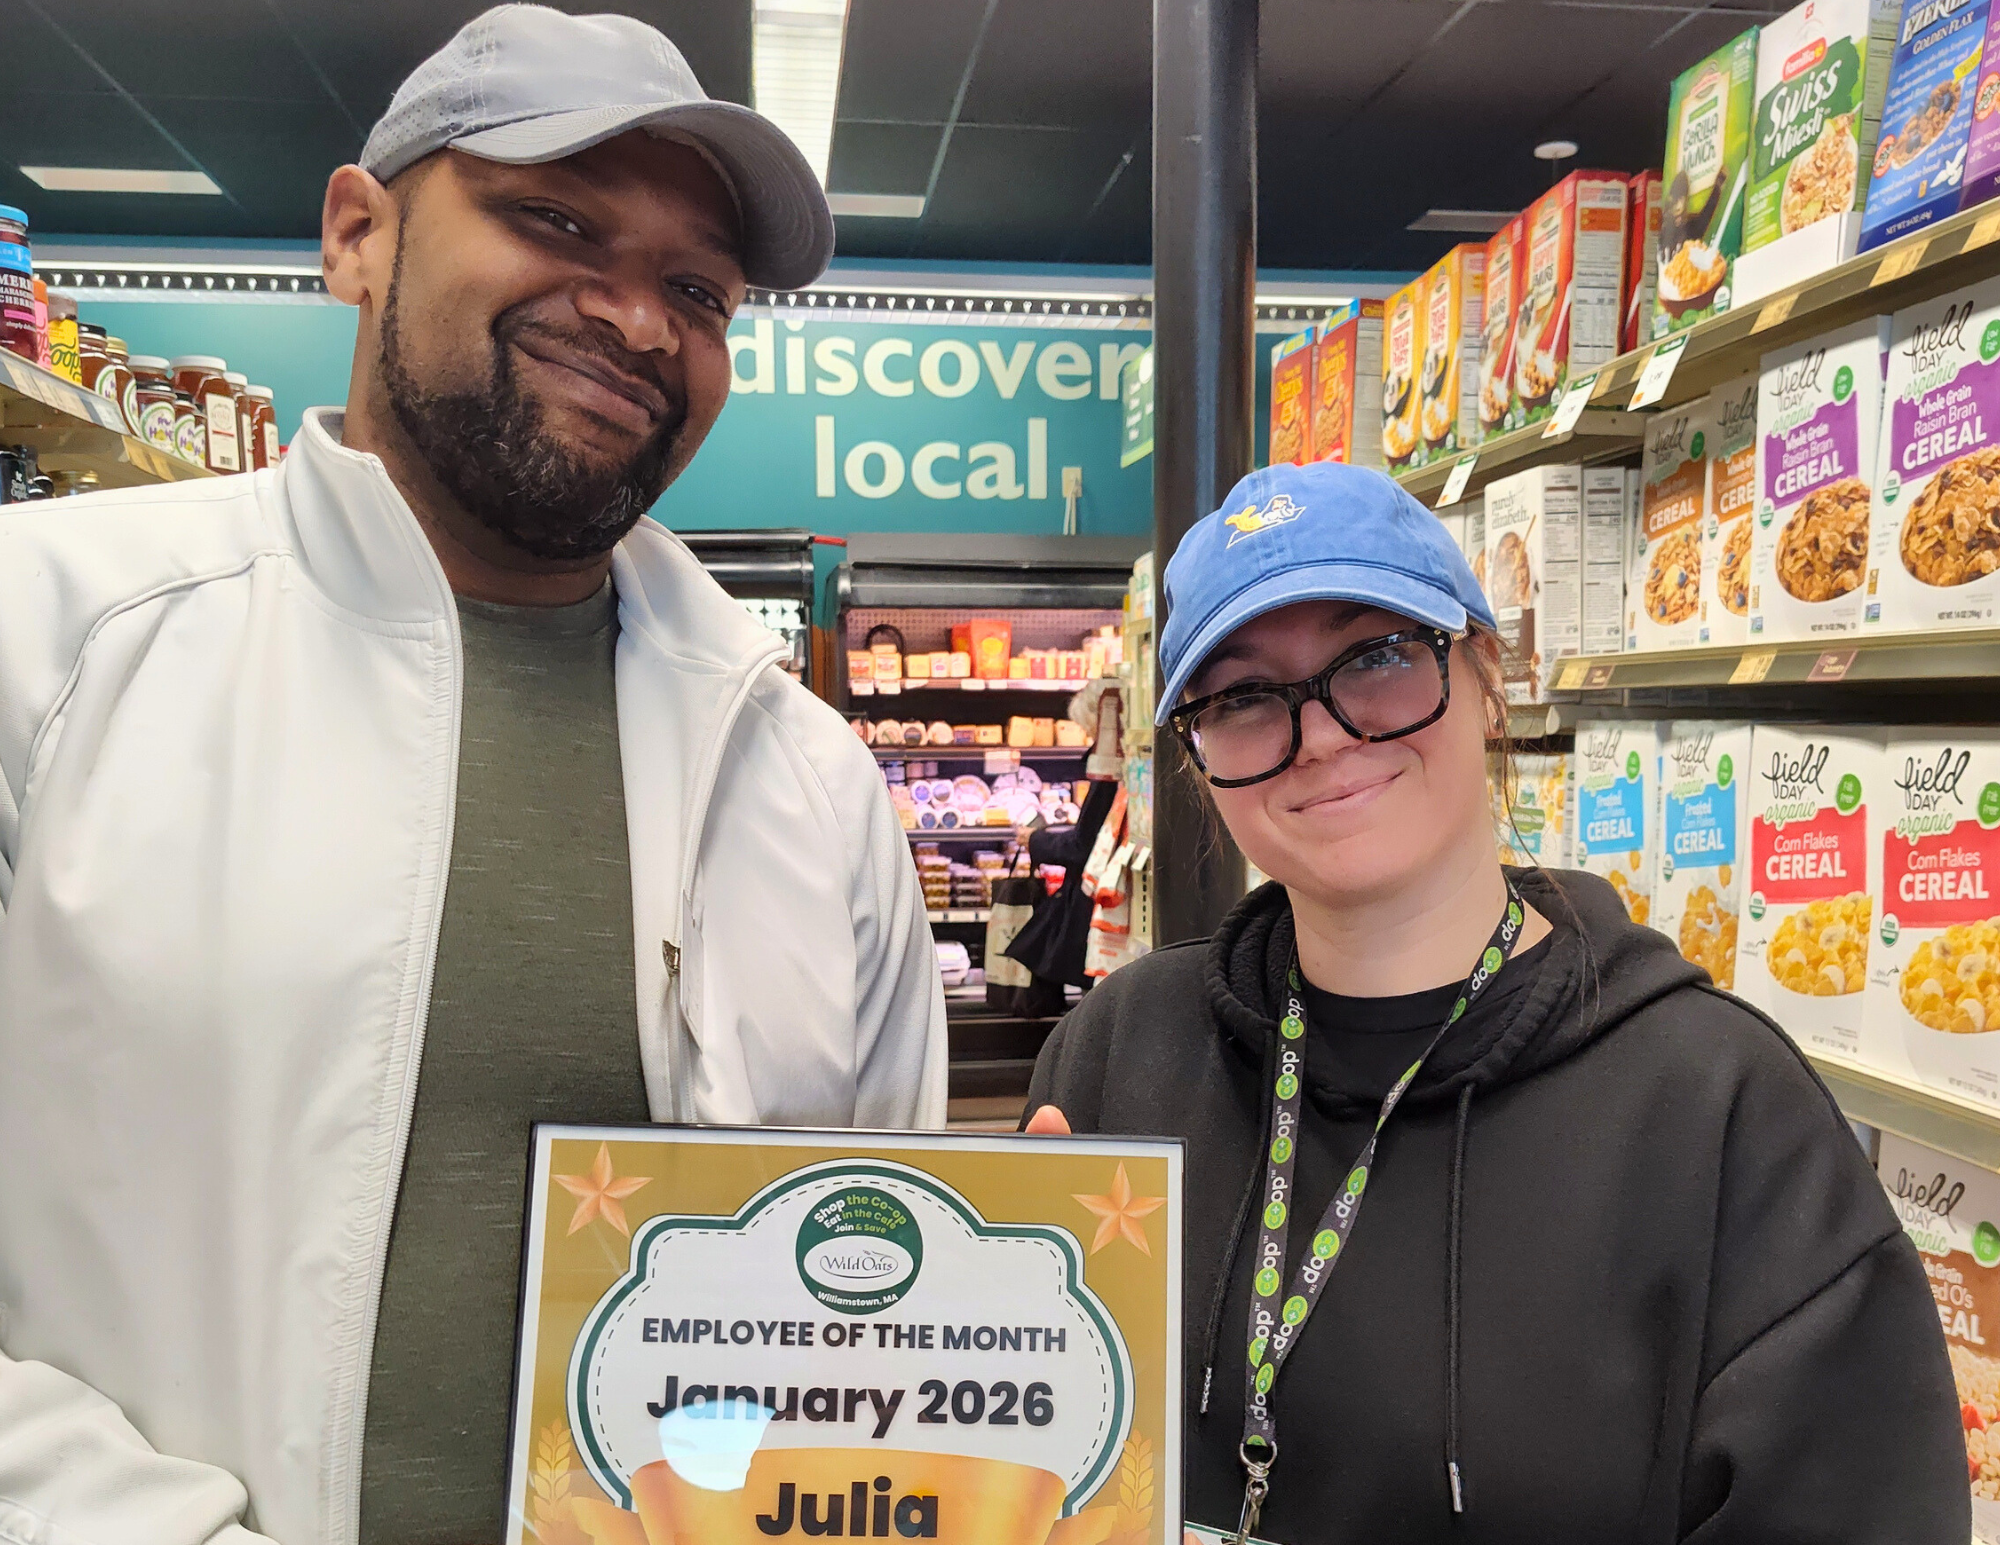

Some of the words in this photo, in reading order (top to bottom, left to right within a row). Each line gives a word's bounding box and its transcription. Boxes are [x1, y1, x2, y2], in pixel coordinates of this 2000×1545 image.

[1948, 10, 1974, 34] FLAX
[1763, 60, 1842, 146] Swiss
[1903, 300, 1974, 374] field
[728, 319, 1147, 400] discover
[1919, 351, 1943, 372] DAY
[1770, 348, 1826, 411] field
[1784, 391, 1806, 411] DAY
[1919, 393, 1946, 418] Whole
[1946, 385, 1972, 405] Grain
[1914, 413, 1946, 439] Raisin
[1949, 401, 1977, 424] Bran
[815, 415, 1048, 499] local
[1903, 416, 1988, 470] CEREAL
[1774, 450, 1844, 498] CEREAL
[1720, 480, 1755, 514] CERE
[1649, 496, 1696, 532] CEREAL
[1761, 744, 1829, 800] field
[1894, 748, 1971, 810] field
[1780, 784, 1806, 800] DAY
[1913, 794, 1941, 811] DAY
[1587, 817, 1635, 842] CEREAL
[1765, 800, 1817, 828] organic
[1898, 811, 1954, 842] organic
[1674, 828, 1725, 854] CEREAL
[1803, 831, 1839, 850] Flakes
[1766, 851, 1847, 881] CEREAL
[1940, 847, 1981, 867] Flakes
[1899, 870, 1989, 902] CEREAL
[814, 1199, 846, 1223] Shop
[846, 1194, 868, 1205] the
[871, 1196, 907, 1225] Co-op
[1887, 1167, 1966, 1234] field
[823, 1214, 842, 1228] Eat
[842, 1211, 853, 1220] in
[854, 1208, 872, 1218] the
[834, 1223, 854, 1233] Join
[864, 1223, 887, 1234] Save
[1906, 1206, 1934, 1230] DAY
[1908, 1229, 1947, 1253] anic
[820, 1255, 860, 1271] Wild
[861, 1256, 893, 1271] Oats
[1935, 1262, 1963, 1284] Grain
[817, 1290, 883, 1306] Williamstown,
[883, 1293, 899, 1304] MA
[642, 1317, 815, 1347] EMPLOYEE
[821, 1322, 863, 1348] OF
[874, 1322, 933, 1350] THE
[942, 1325, 1067, 1353] MONTH
[1939, 1304, 1985, 1345] EAL
[646, 1375, 906, 1439] January
[916, 1379, 1055, 1426] 2026
[756, 1475, 939, 1538] Julia
